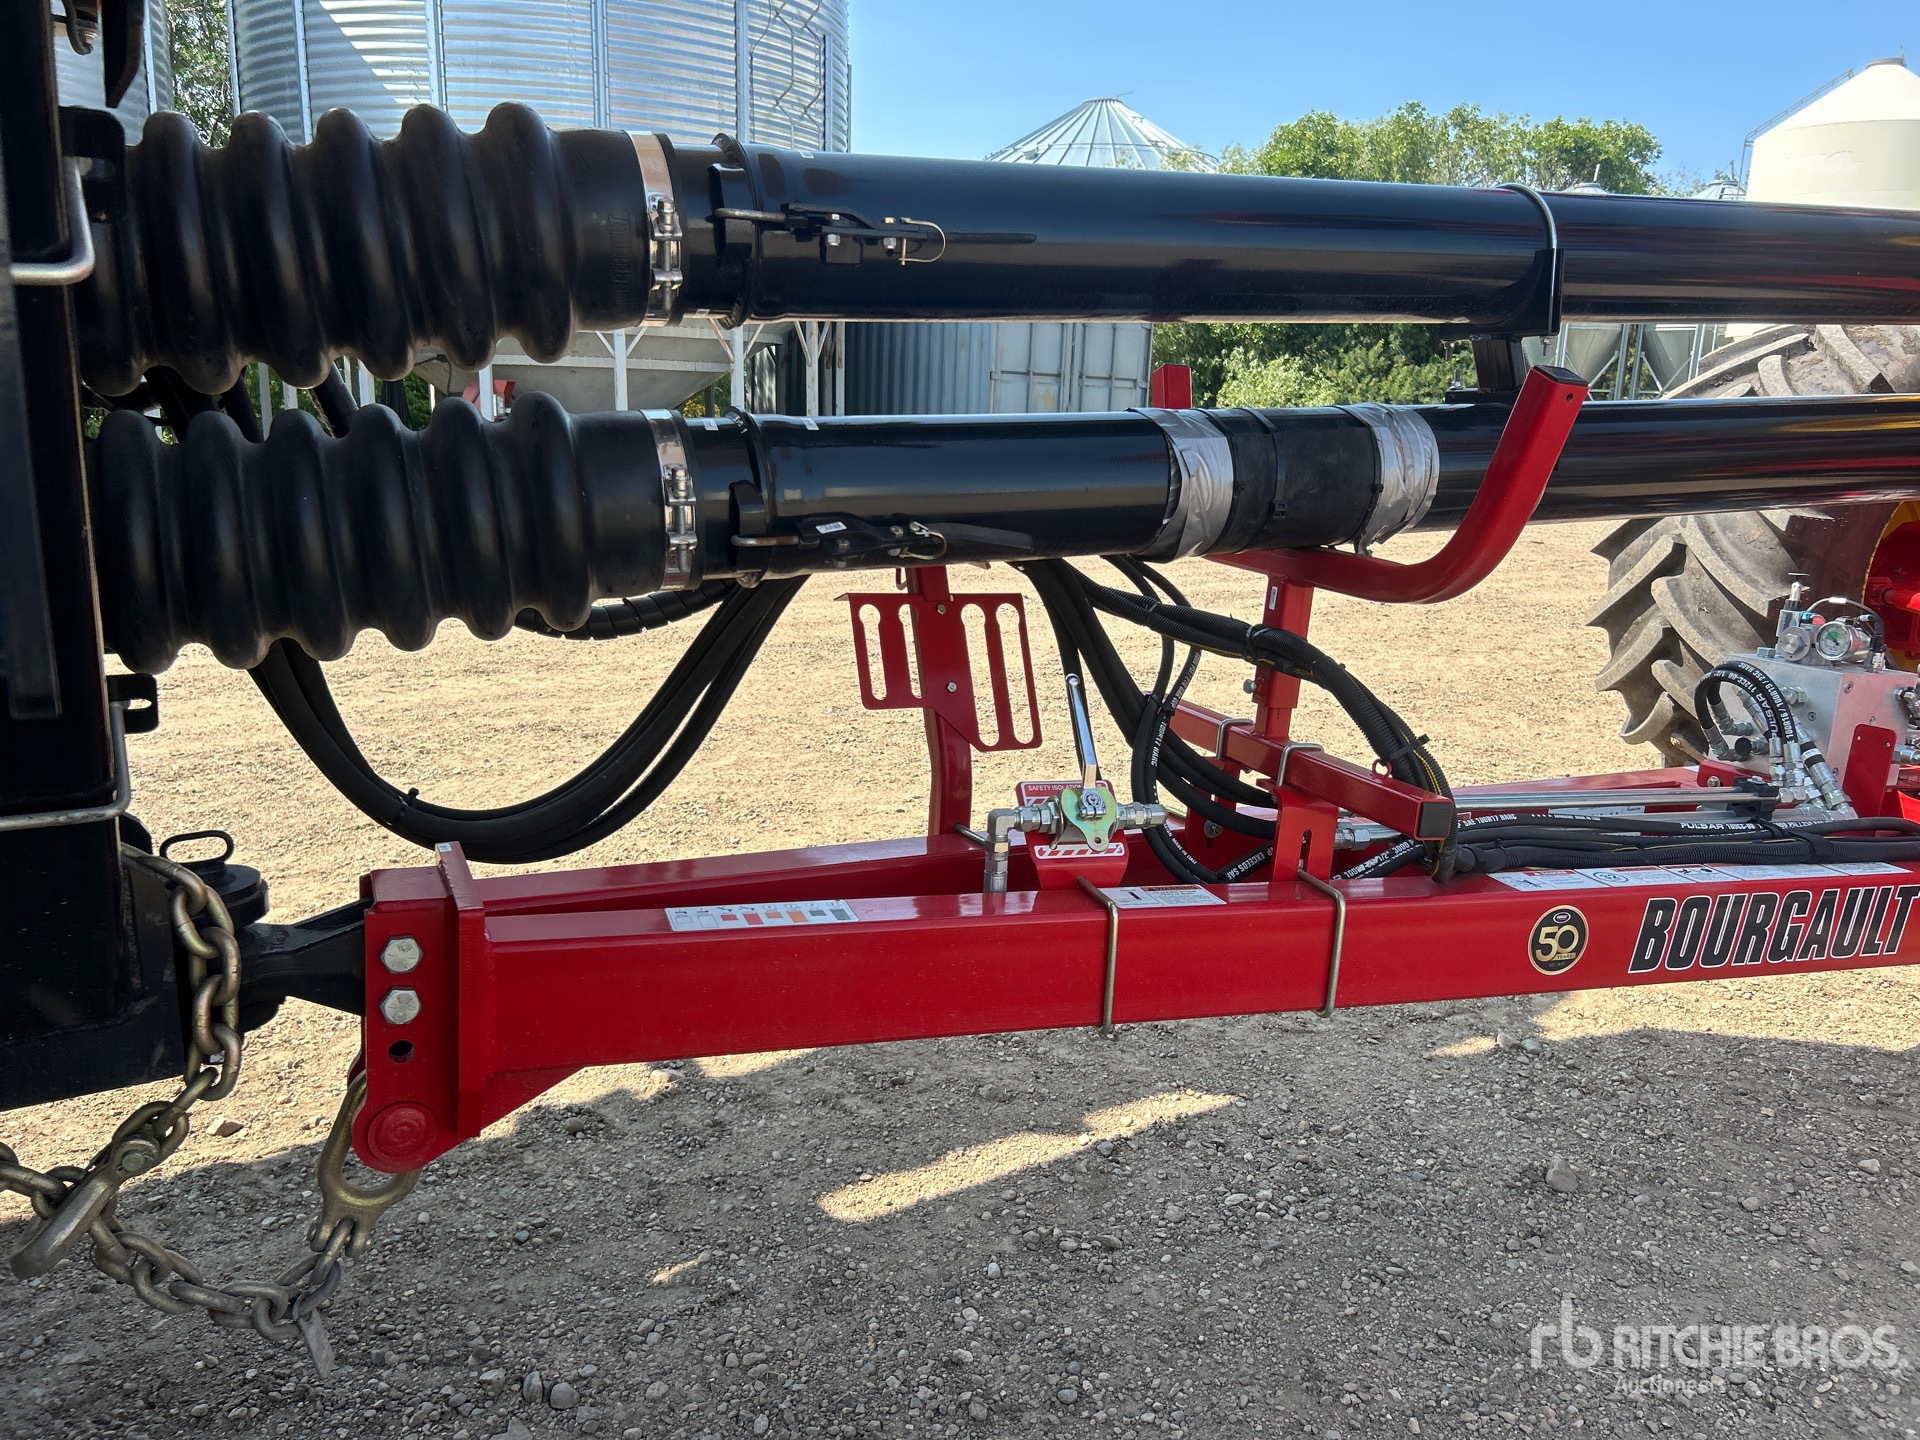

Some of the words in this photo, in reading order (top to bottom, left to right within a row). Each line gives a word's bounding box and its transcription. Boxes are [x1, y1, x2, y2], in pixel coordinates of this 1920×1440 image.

[1765, 684, 1784, 708] 100R19
[1680, 822, 1724, 830] PULSAR
[1238, 852, 1266, 872] EXCEEDS
[1628, 884, 1920, 973] BOURGAULT
[1536, 924, 1579, 962] 50
